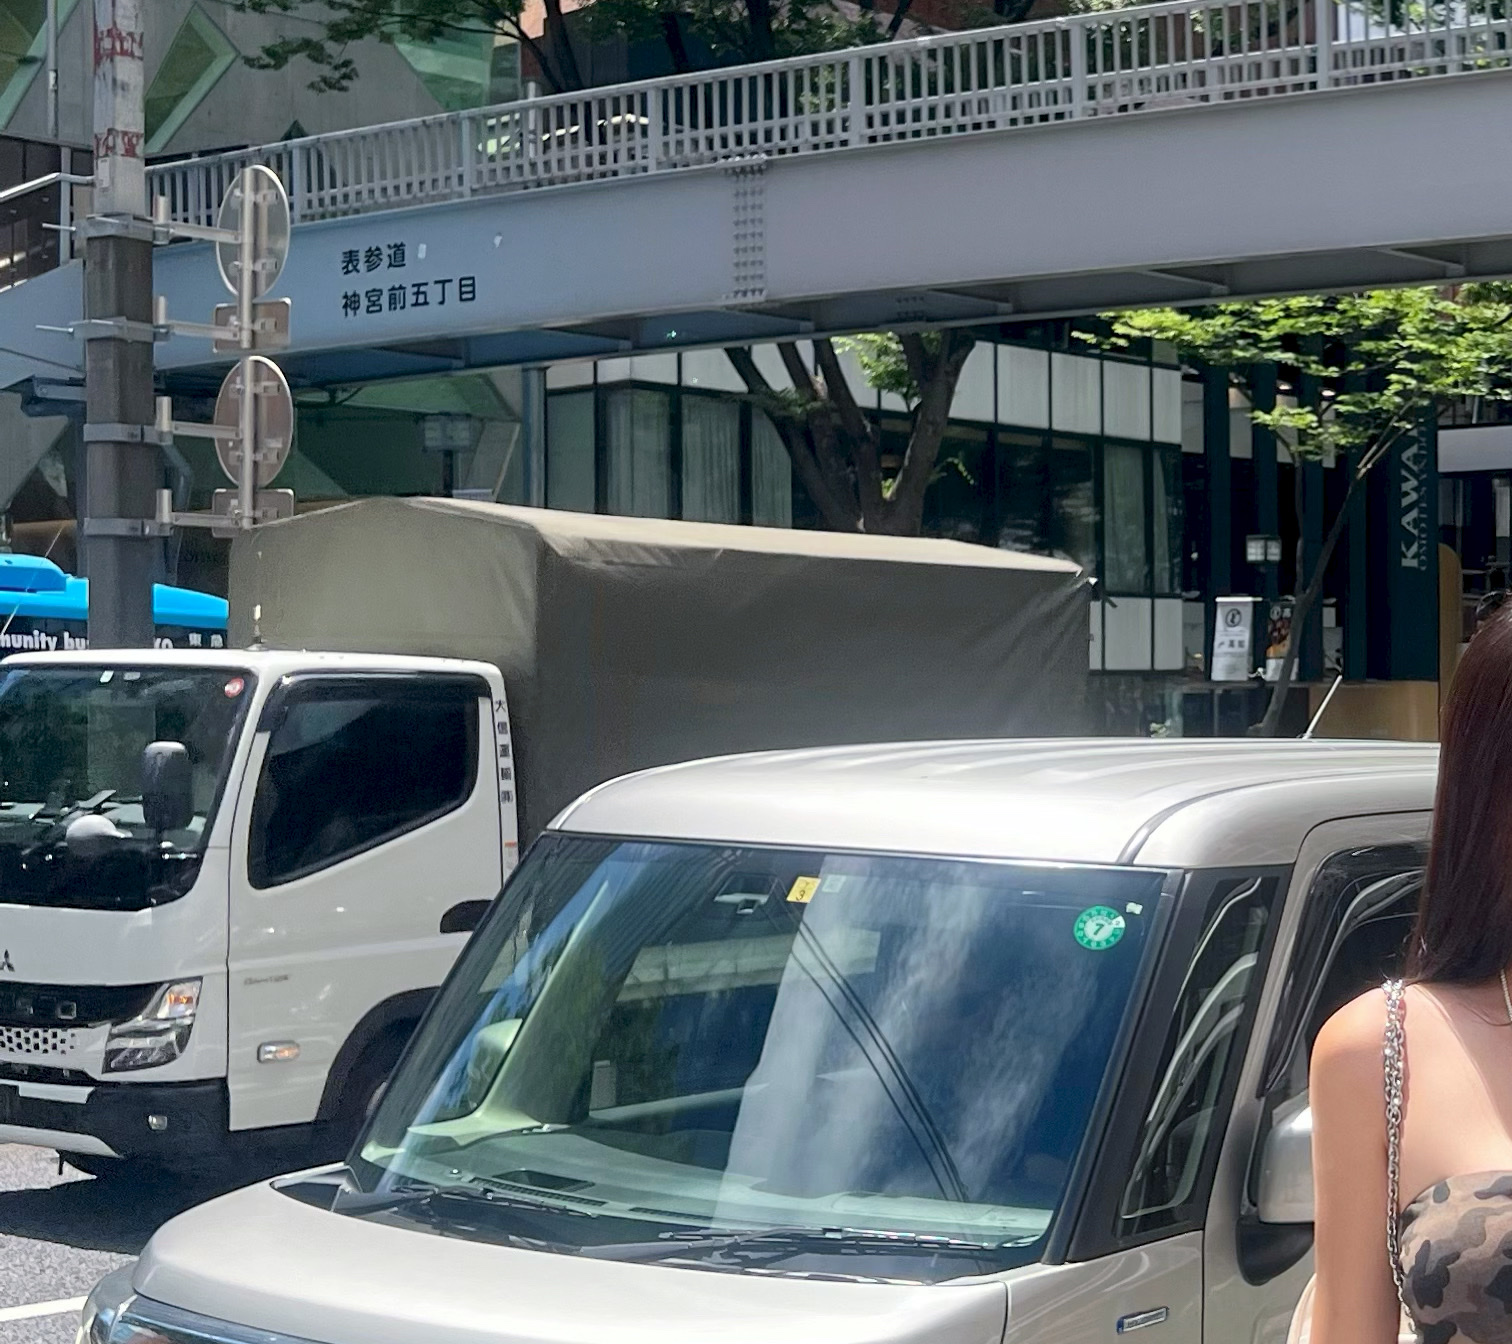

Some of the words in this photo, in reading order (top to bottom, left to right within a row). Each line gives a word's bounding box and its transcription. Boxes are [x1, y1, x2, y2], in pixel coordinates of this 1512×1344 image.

[341, 241, 407, 276] 表参道
[341, 275, 477, 318] 神宮前五丁目
[63, 631, 90, 650] bu
[1093, 922, 1105, 936] 7
